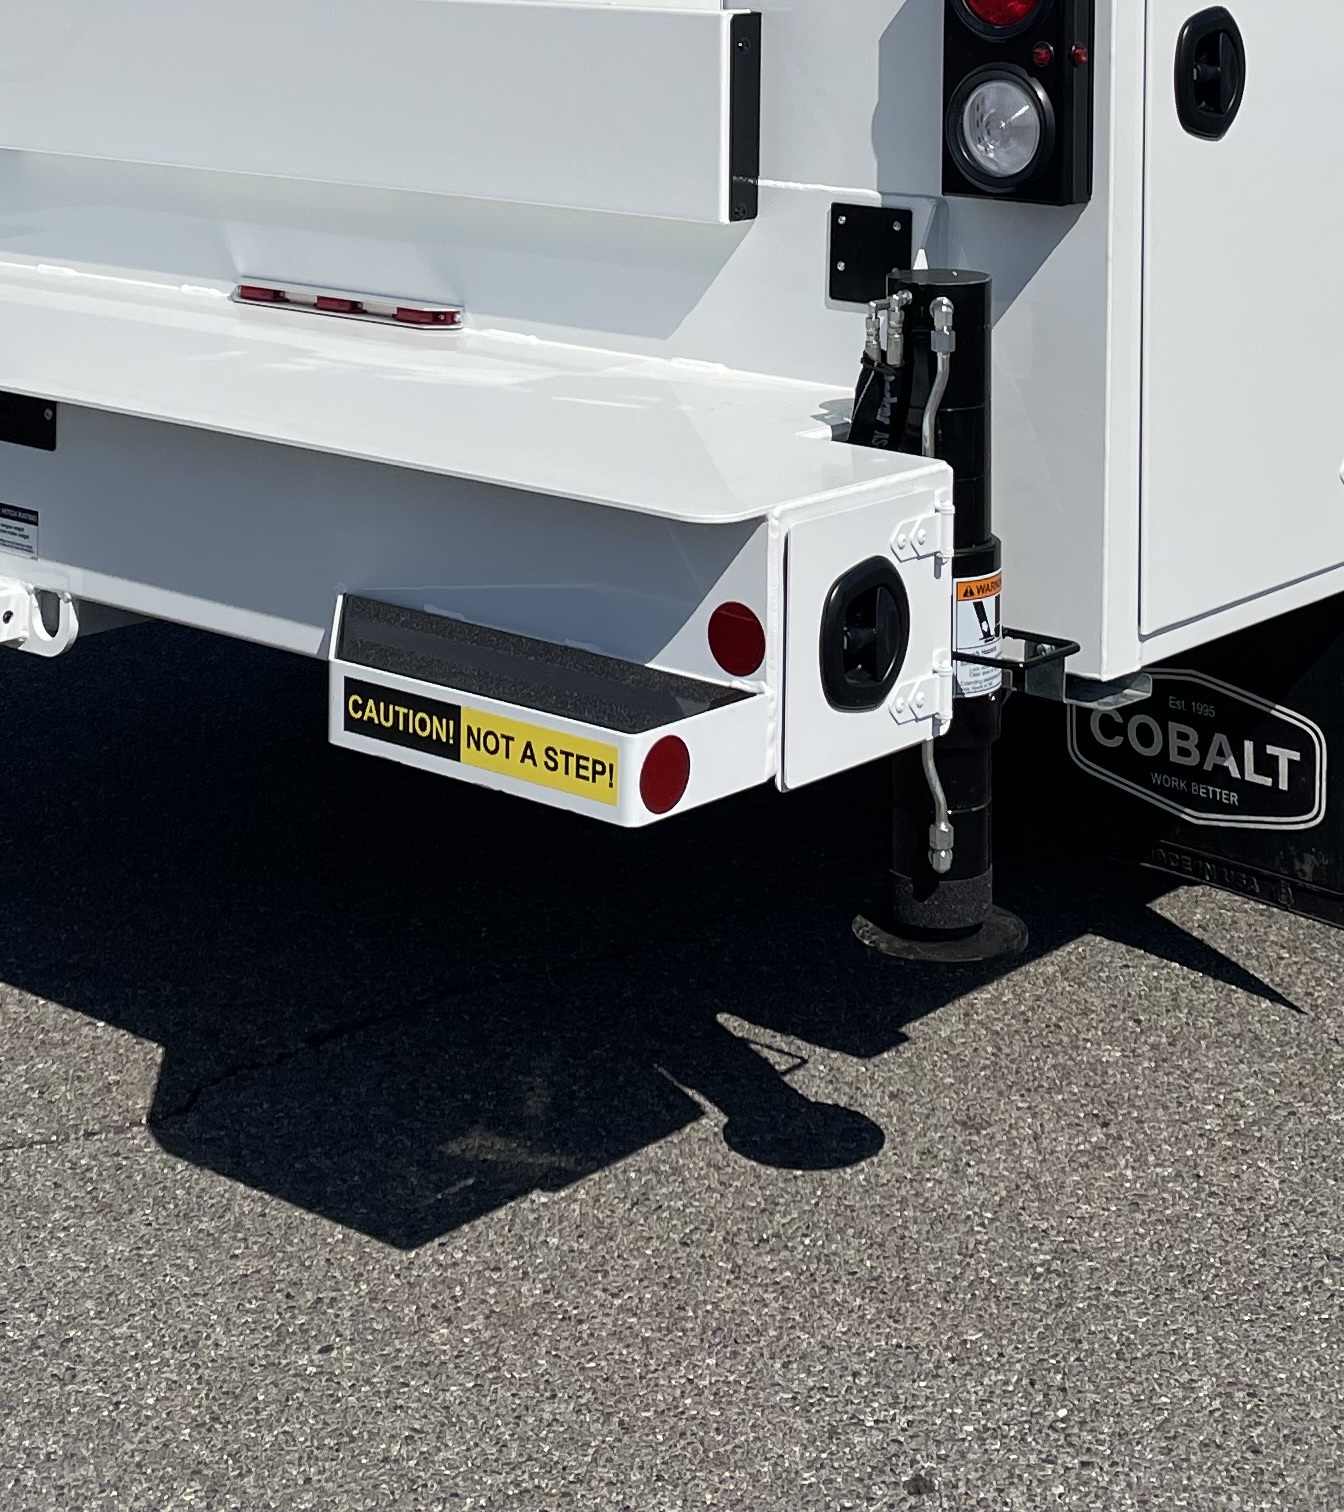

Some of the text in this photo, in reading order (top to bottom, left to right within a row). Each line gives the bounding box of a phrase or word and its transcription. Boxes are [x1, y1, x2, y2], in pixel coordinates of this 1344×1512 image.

[348, 695, 615, 789] CAUTION! NOT A STEP!
[1090, 709, 1301, 792] COBALT
[1150, 772, 1239, 807] WORK BETTER
